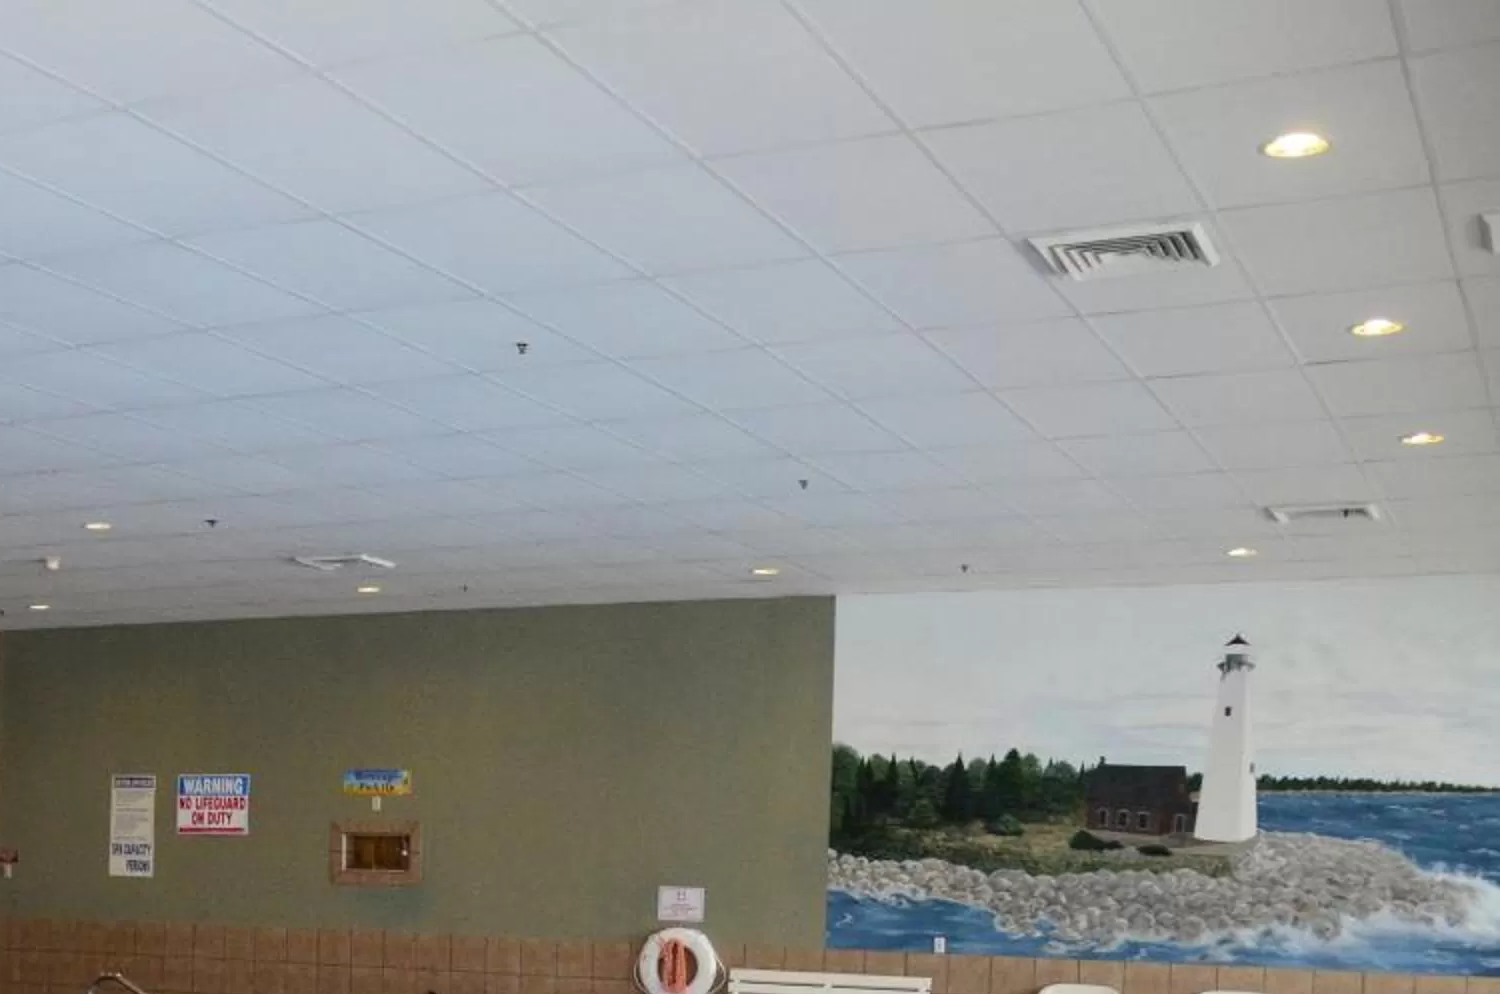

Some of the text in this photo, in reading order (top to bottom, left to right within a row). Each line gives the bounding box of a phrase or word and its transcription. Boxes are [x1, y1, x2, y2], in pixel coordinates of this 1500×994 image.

[183, 777, 243, 795] WARNING
[179, 797, 245, 810] NO LIFEGUARD
[191, 811, 233, 825] ON DUTY
